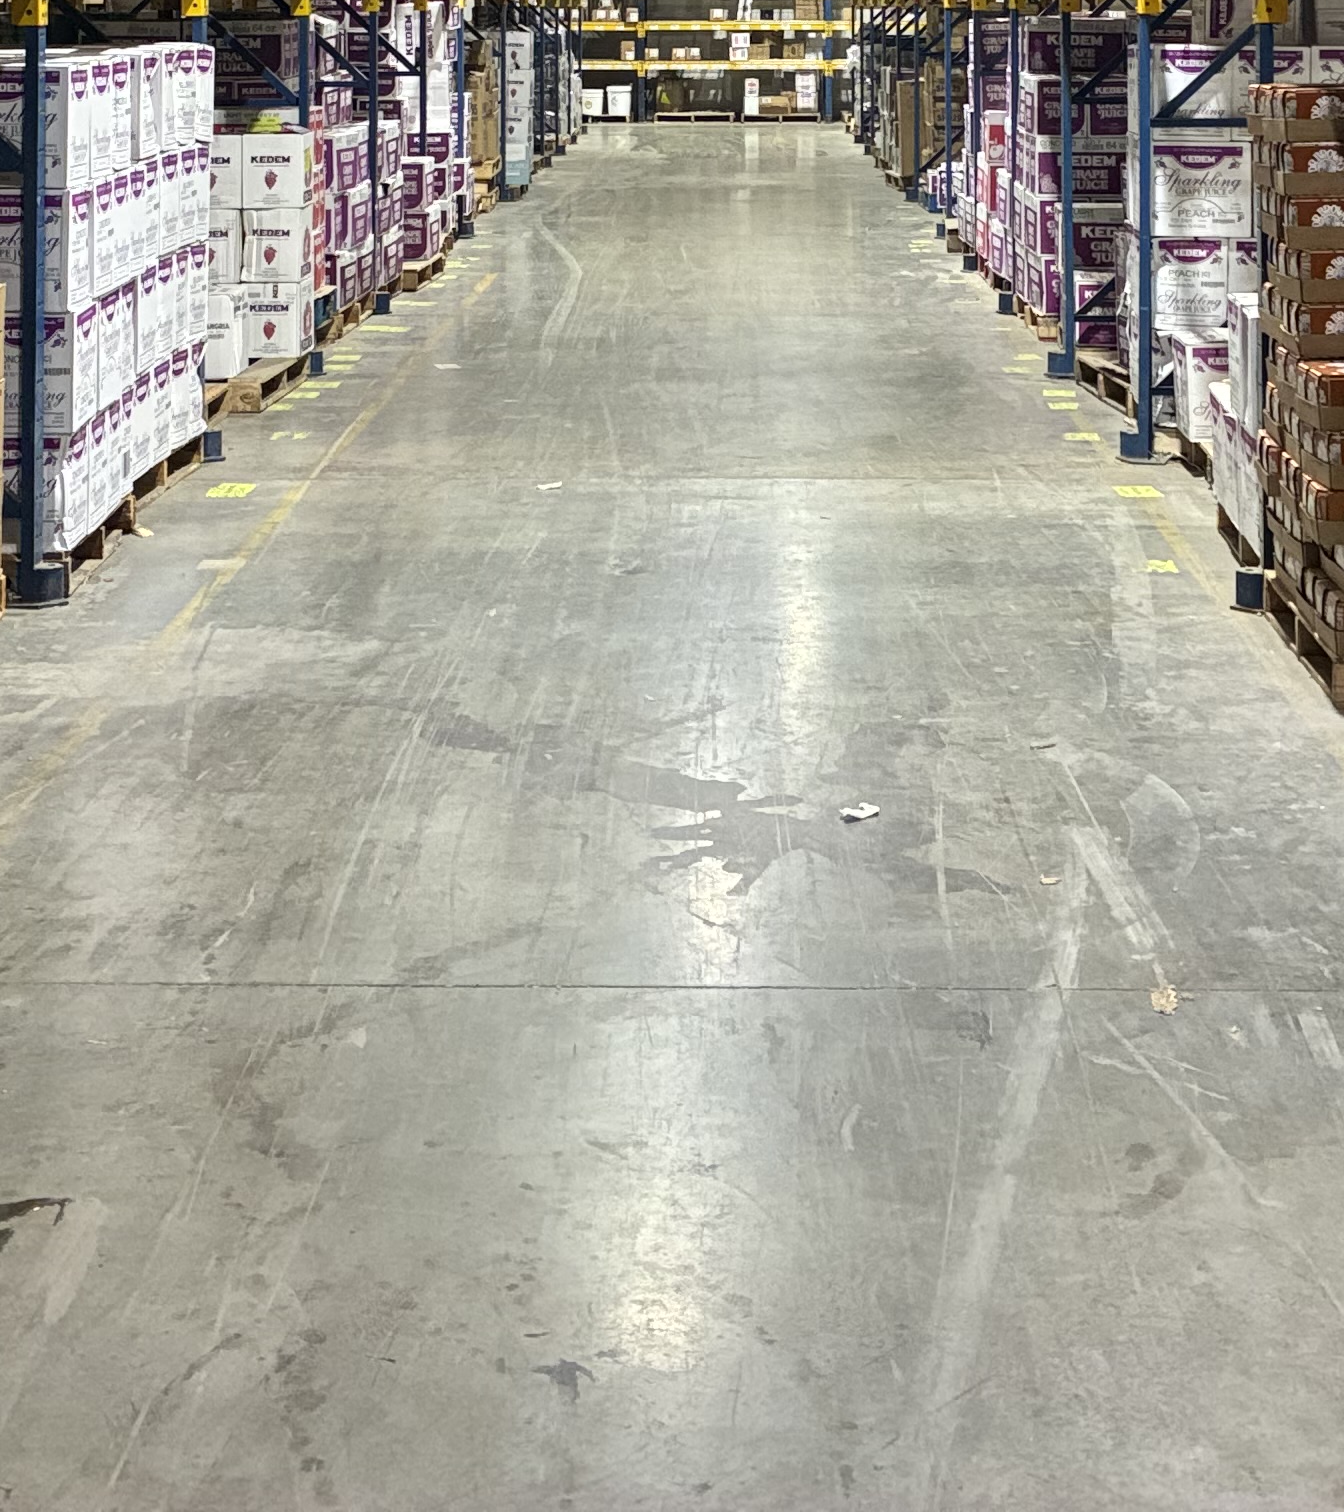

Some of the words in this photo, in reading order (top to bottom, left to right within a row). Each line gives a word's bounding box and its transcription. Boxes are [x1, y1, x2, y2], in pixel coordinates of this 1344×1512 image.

[405, 15, 413, 56] KEDEM
[1047, 34, 1103, 46] KDEM
[251, 155, 291, 165] KEDEM
[1181, 155, 1217, 164] KEDEM
[1154, 168, 1241, 194] Sparkling
[1177, 209, 1215, 218] PEACH
[252, 228, 290, 238] KEDEM
[1169, 269, 1199, 278] PEACH
[1158, 290, 1221, 309] Sparkling
[250, 304, 289, 313] KEDEM
